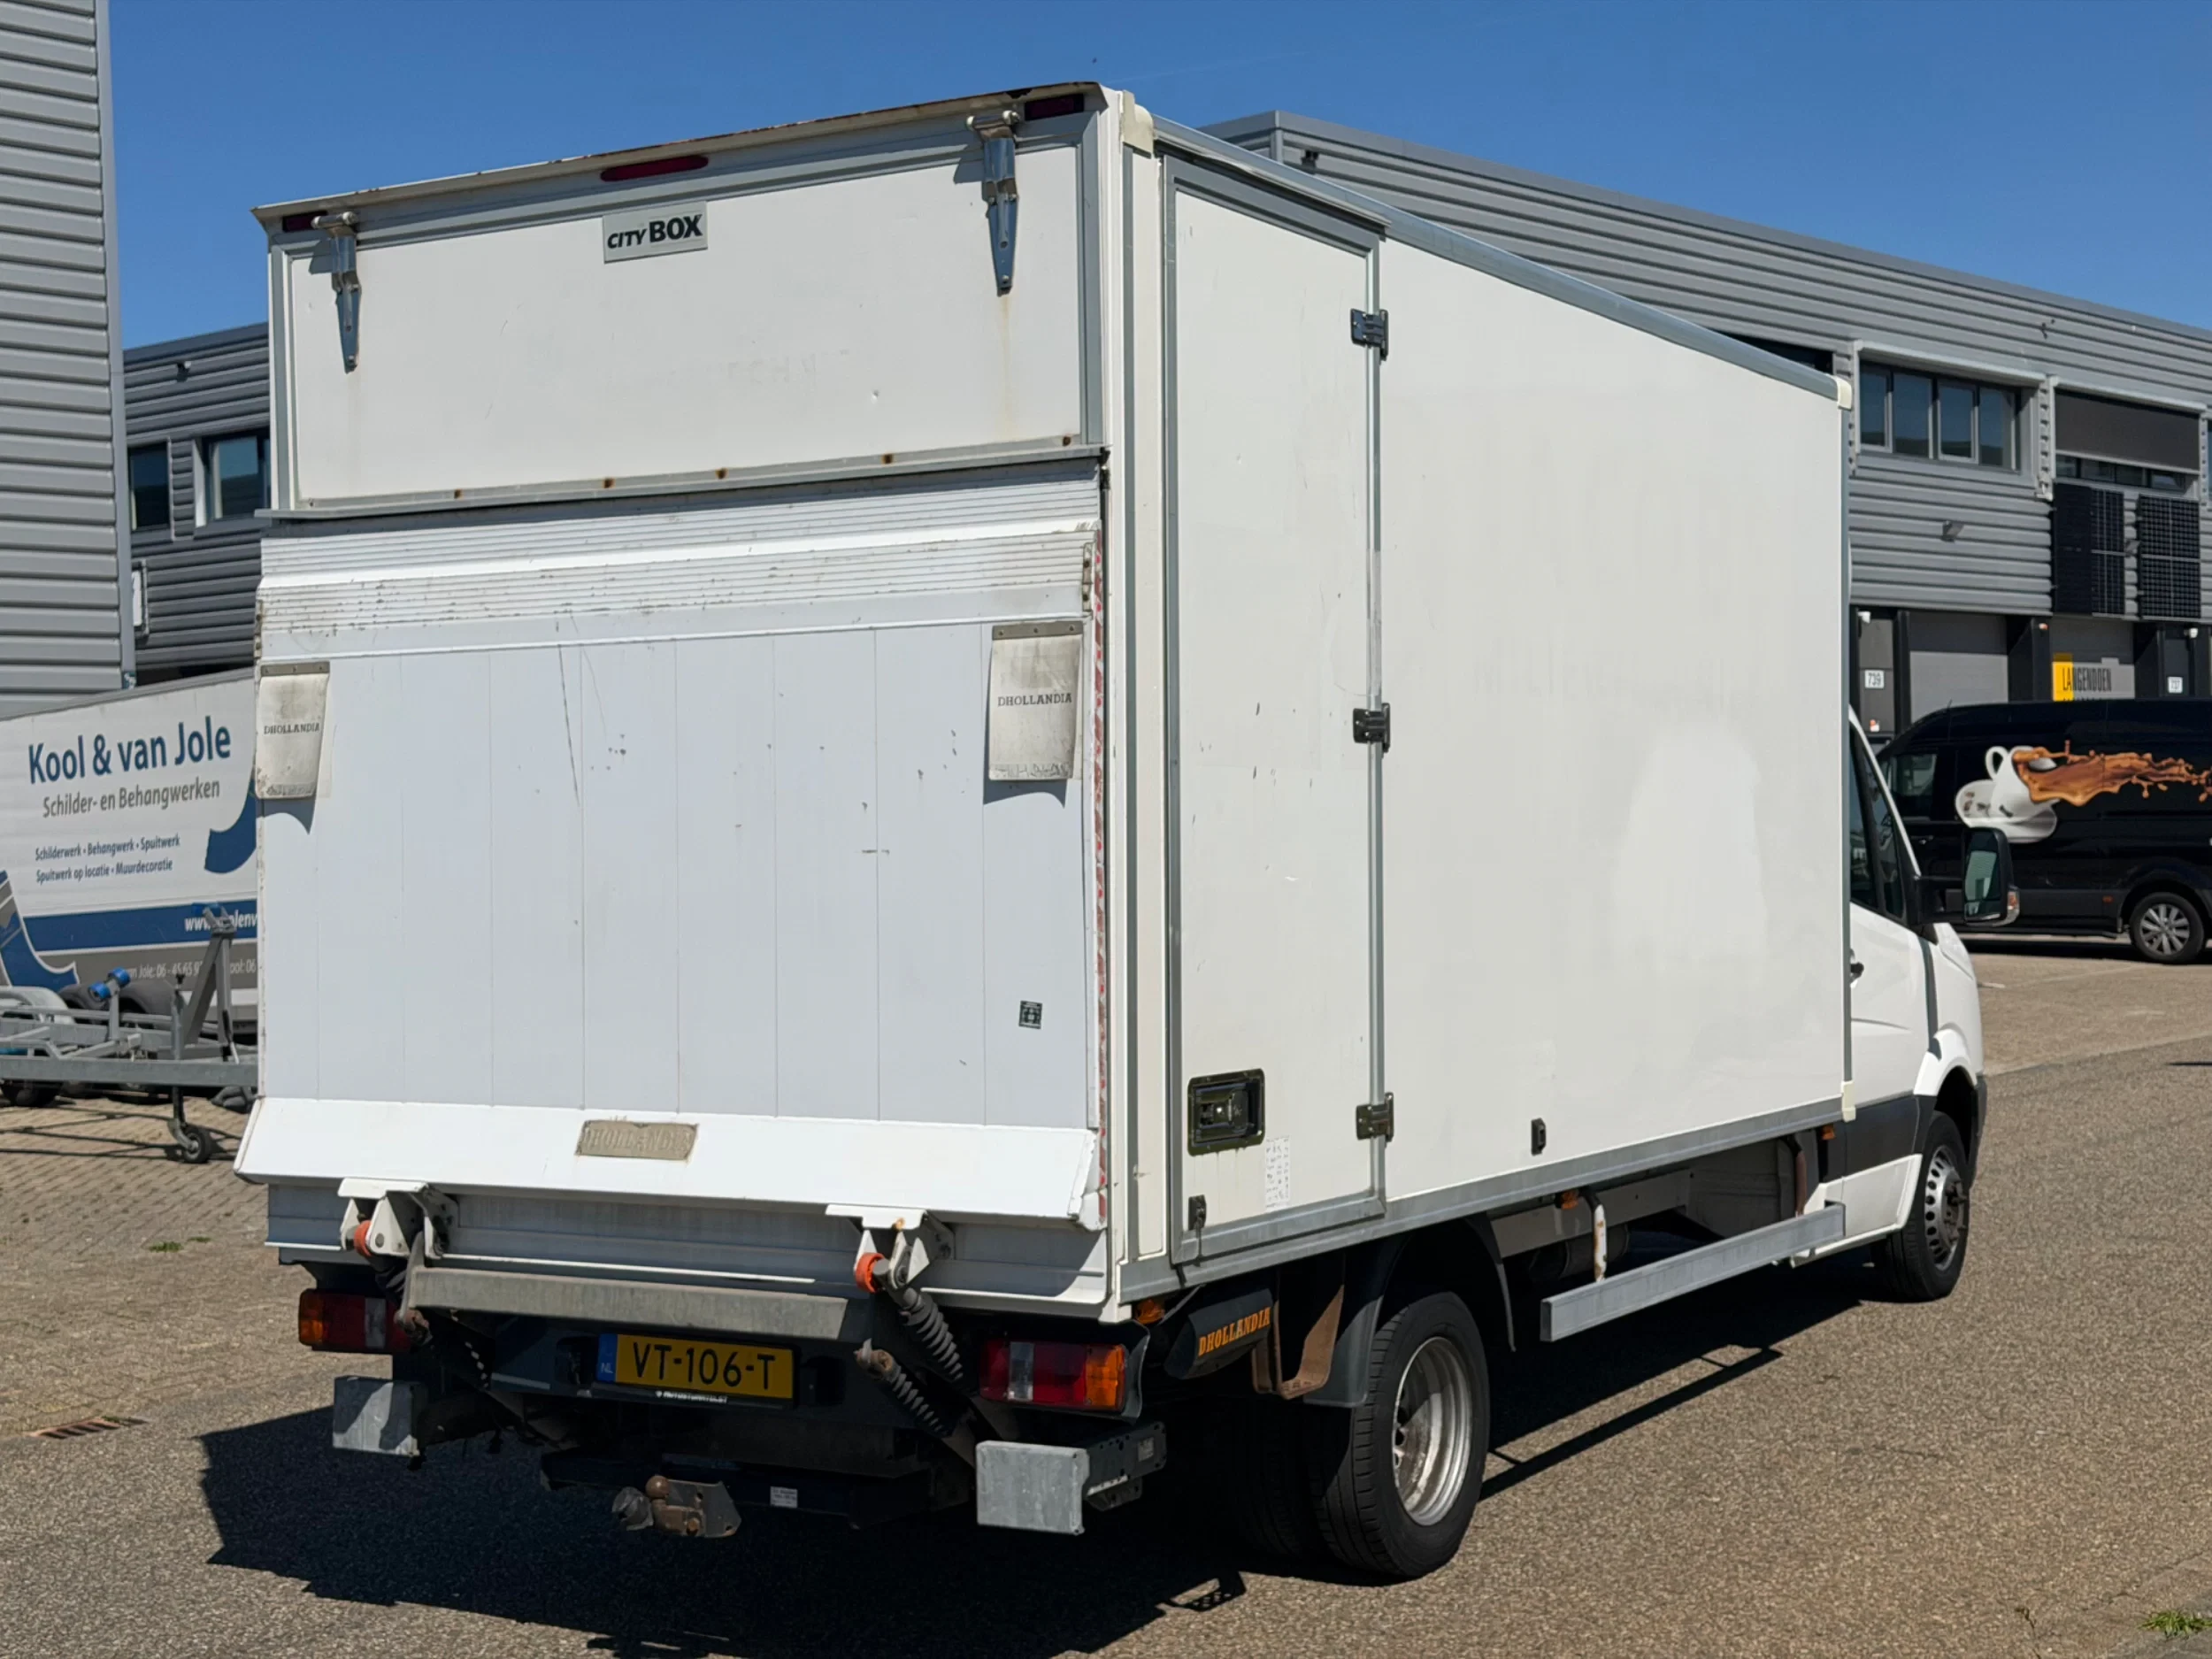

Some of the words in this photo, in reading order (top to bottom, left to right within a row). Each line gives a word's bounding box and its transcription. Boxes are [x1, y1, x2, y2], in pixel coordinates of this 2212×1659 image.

[607, 228, 648, 250] CITY
[649, 214, 703, 243] BOX
[997, 692, 1072, 708] DHOLLANDIA
[264, 722, 320, 735] DHOLLANDIA
[28, 734, 86, 784] Kool
[93, 733, 112, 776] &
[118, 735, 166, 772] van
[174, 715, 231, 765] Jole
[42, 792, 97, 818] Schilder-
[100, 795, 115, 811] en
[119, 777, 220, 810] Behangwerken
[35, 843, 81, 861] Schilderwerk
[88, 839, 134, 857] Behangwerk
[141, 832, 180, 853] Spuitwerk
[36, 867, 72, 885] Spuitwerk
[73, 869, 83, 882] op
[85, 864, 109, 878] locatie
[116, 857, 173, 875] Muurdecoratie
[157, 962, 166, 978] 06
[246, 958, 257, 974] 06
[1197, 1306, 1271, 1357] DHOLLANDIA
[601, 1363, 613, 1374] NL
[633, 1341, 775, 1390] VT-106-T
